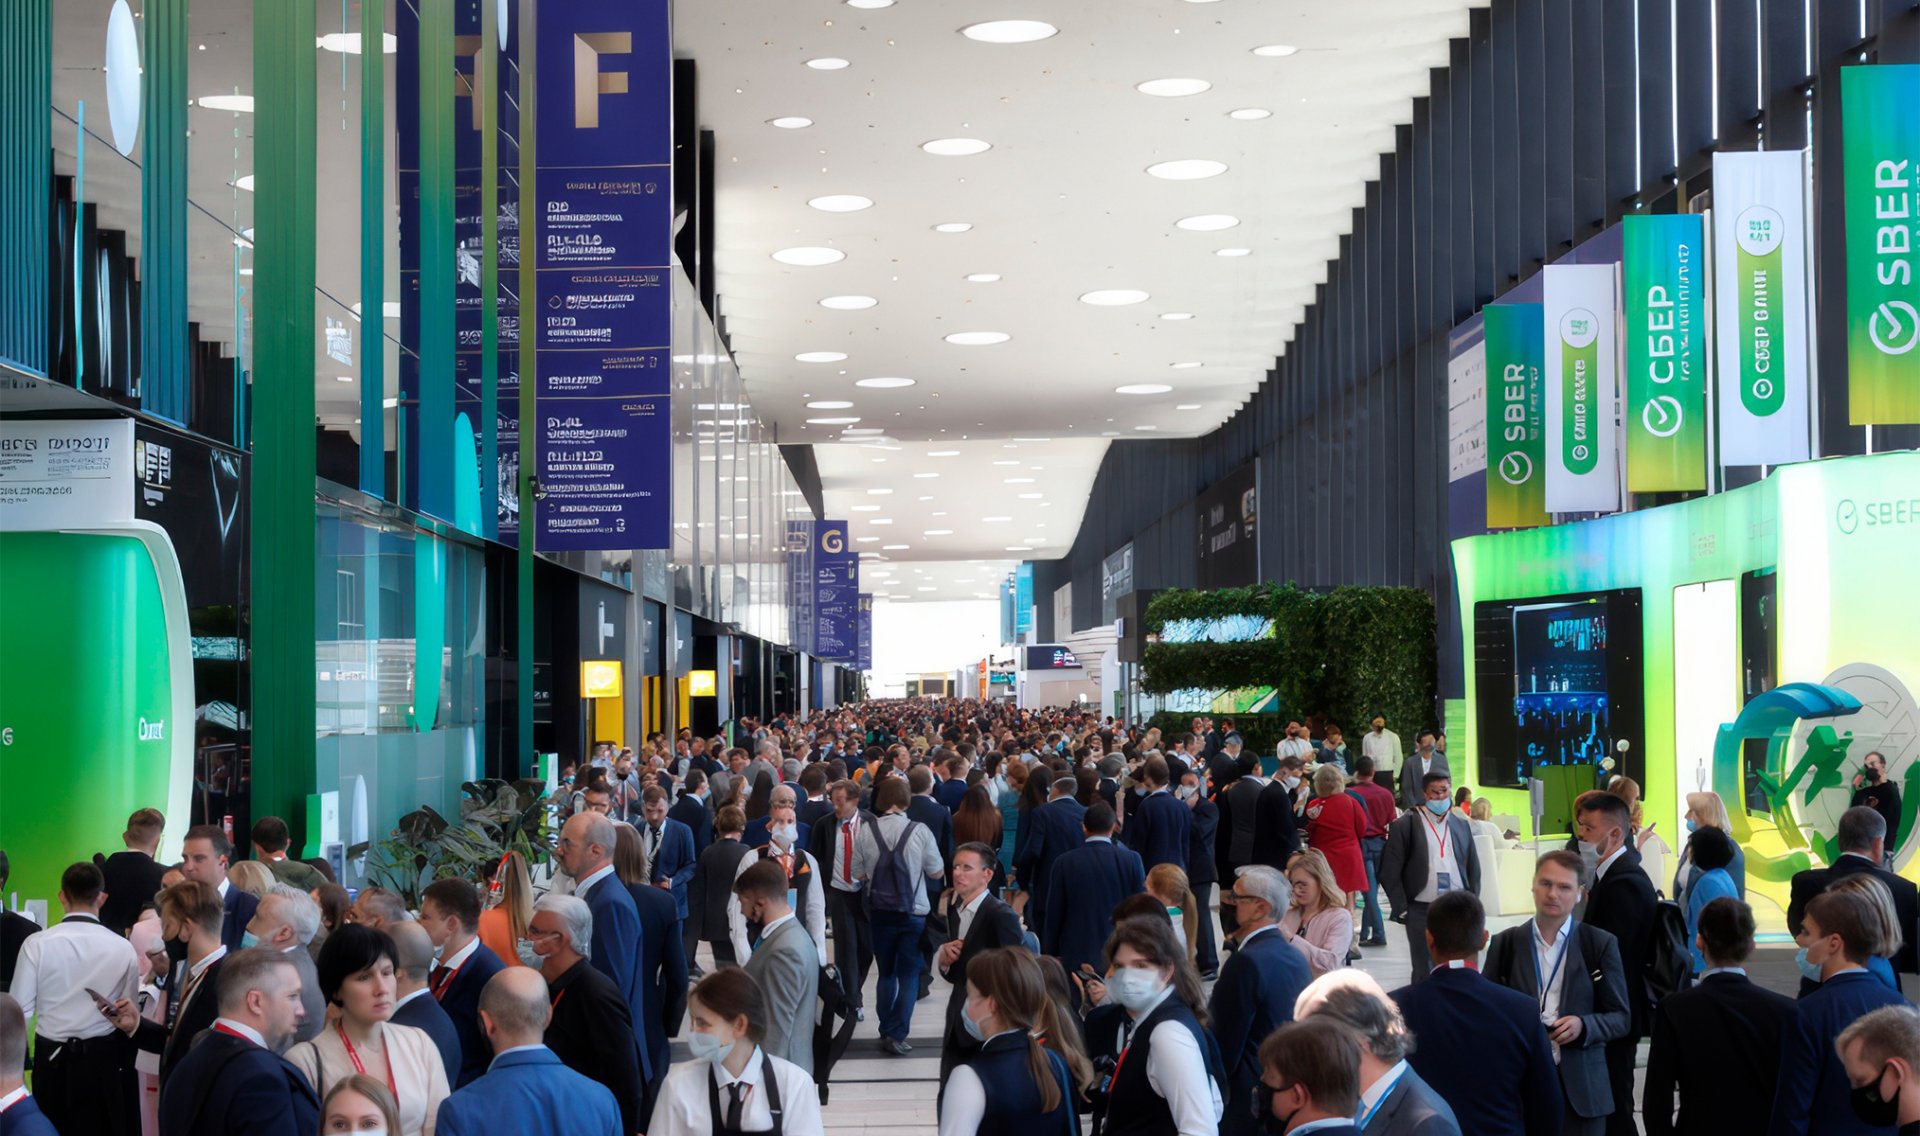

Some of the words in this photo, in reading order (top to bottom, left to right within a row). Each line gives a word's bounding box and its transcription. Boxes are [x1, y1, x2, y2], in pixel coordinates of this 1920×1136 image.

[573, 31, 632, 129] F
[1875, 159, 1911, 286] SBER
[1647, 285, 1675, 384] СБЕР
[1503, 363, 1527, 442] SBER
[821, 529, 843, 554] G
